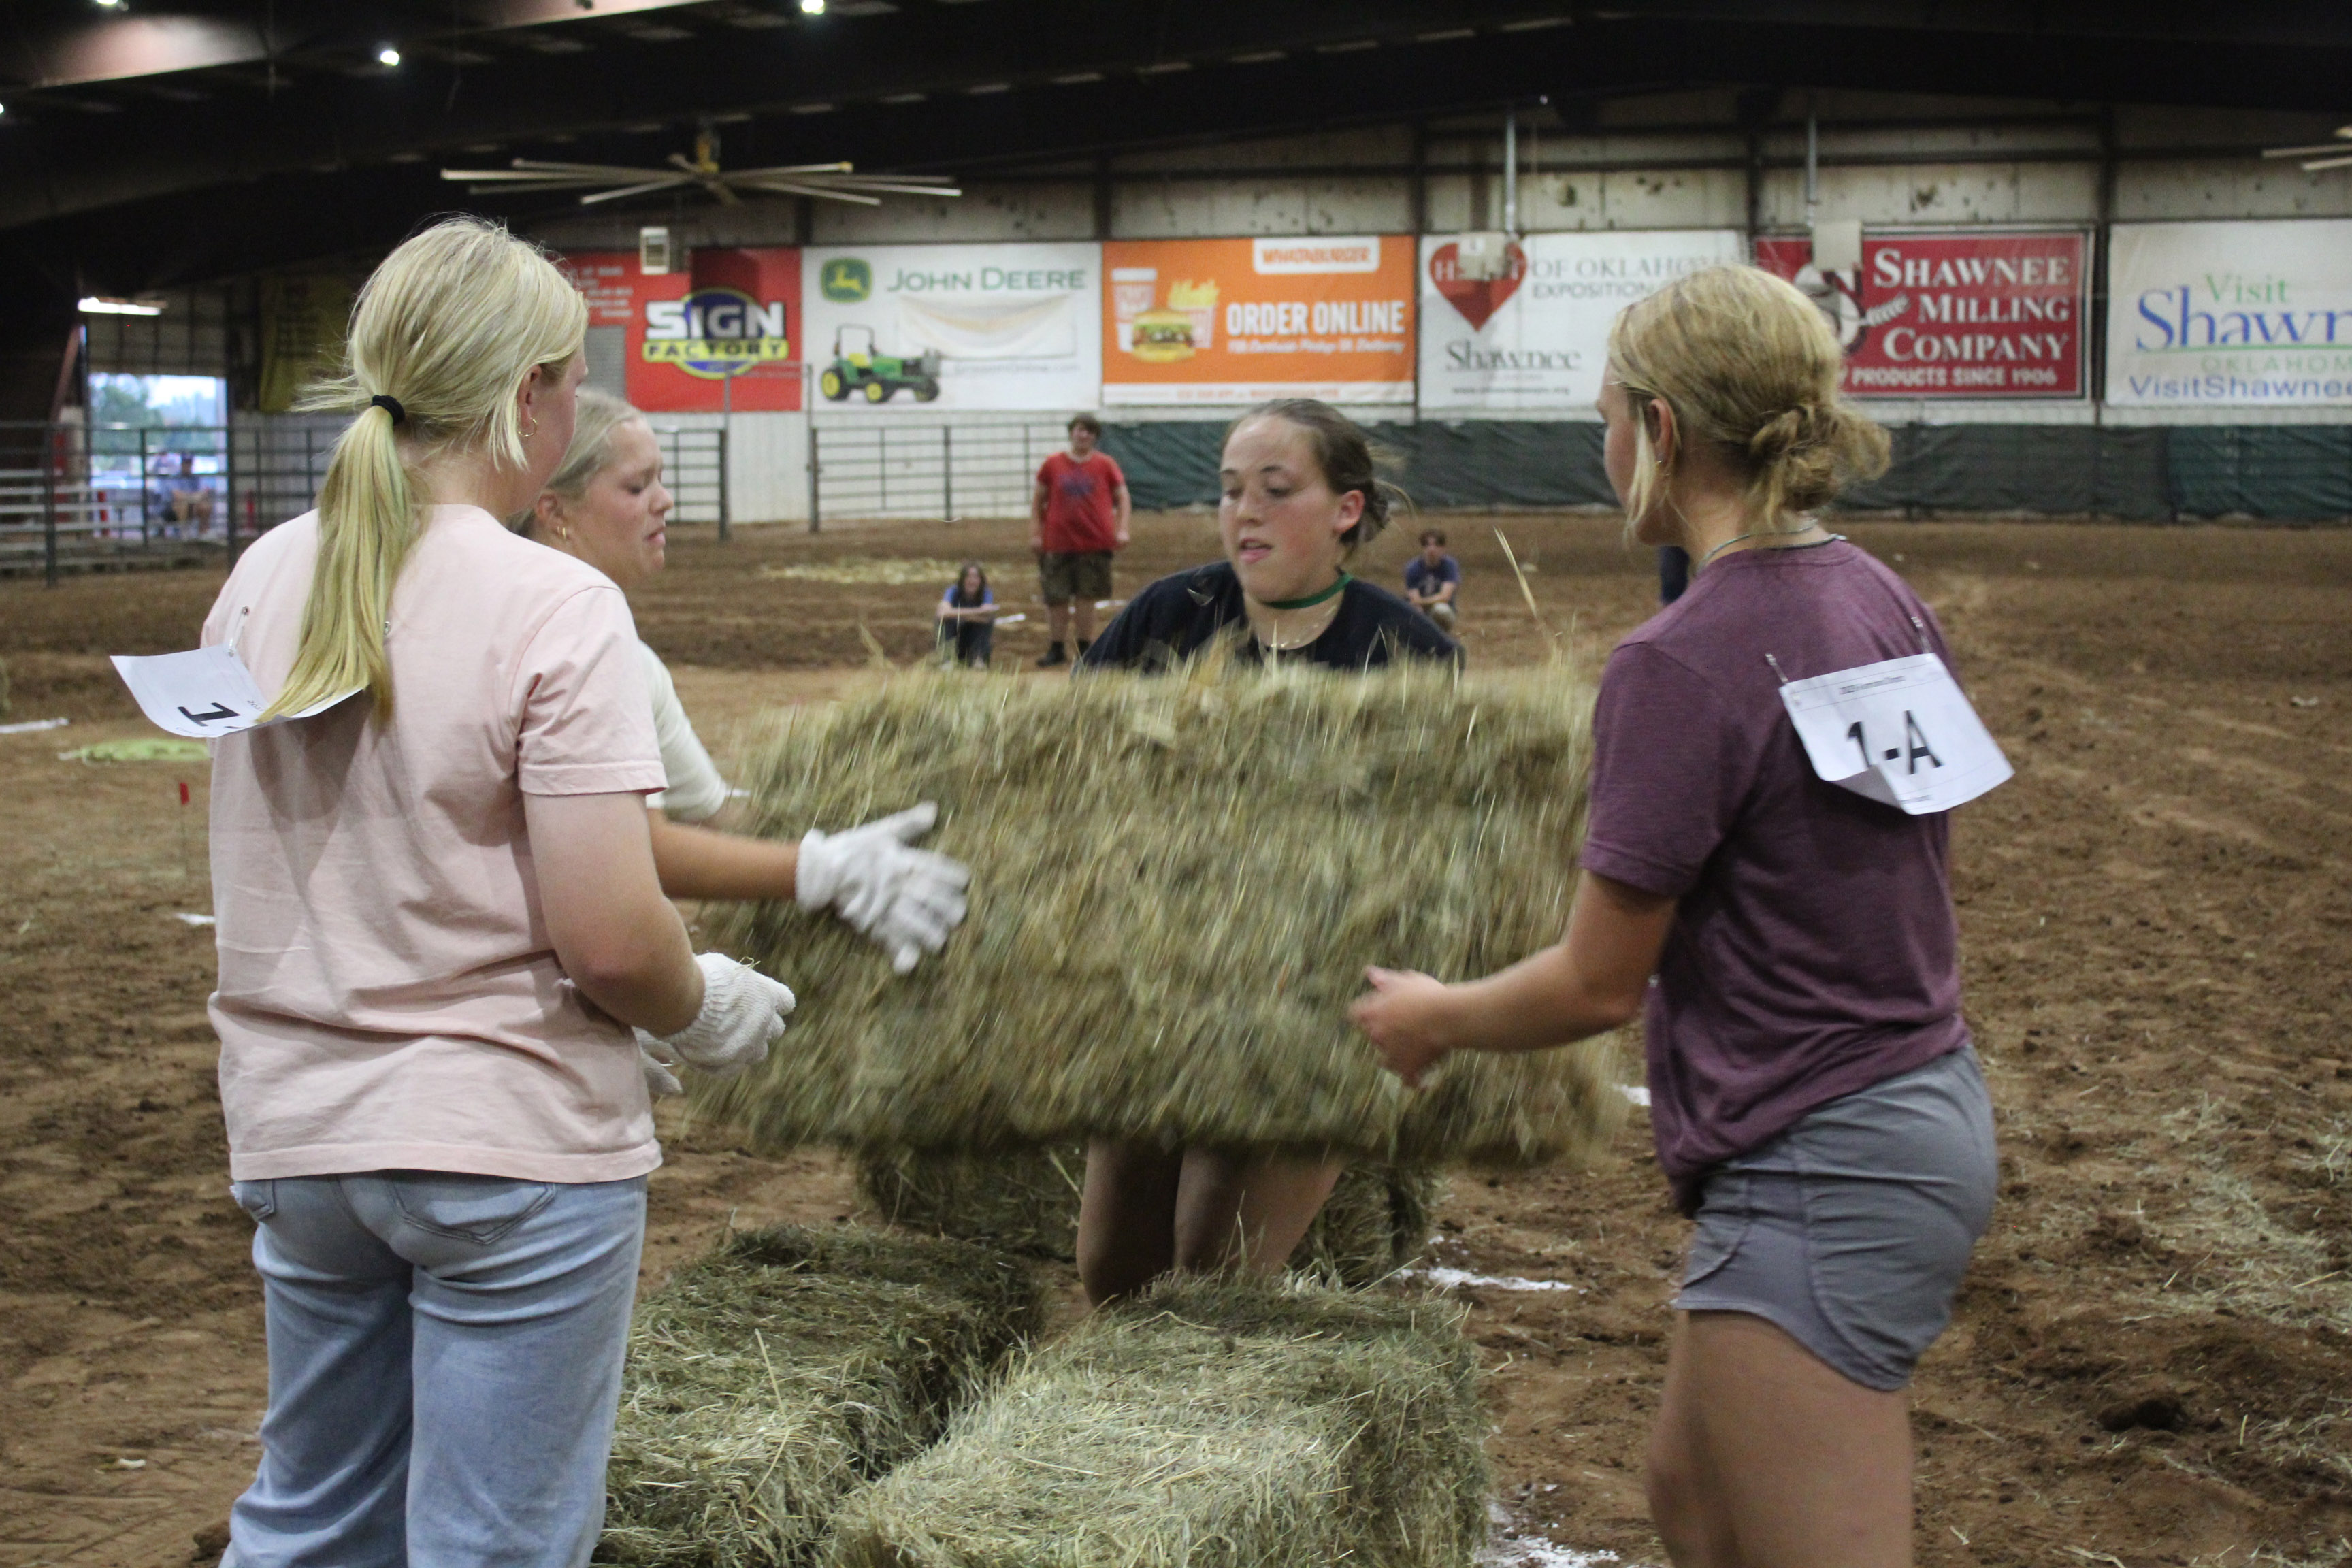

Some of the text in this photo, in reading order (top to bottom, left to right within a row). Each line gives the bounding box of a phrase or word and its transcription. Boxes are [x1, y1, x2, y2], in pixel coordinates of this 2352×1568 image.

[886, 267, 1088, 292] JOHN DEERE
[1531, 257, 1564, 278] OF
[1874, 248, 2070, 288] SHAWNEE
[2205, 274, 2287, 304] Visit
[646, 301, 784, 339] SIGN
[1226, 300, 1405, 336] ORDER ONLINE
[1918, 293, 2070, 323] MILLING
[649, 343, 781, 357] FACTORY
[1446, 340, 1581, 372] Shawnee
[1882, 326, 2070, 362] COMPANY
[1851, 366, 1947, 387] PRODUCTS
[1951, 366, 2007, 386] SINCE
[2012, 365, 2058, 386] 1906
[1846, 709, 1945, 775] 1-A
